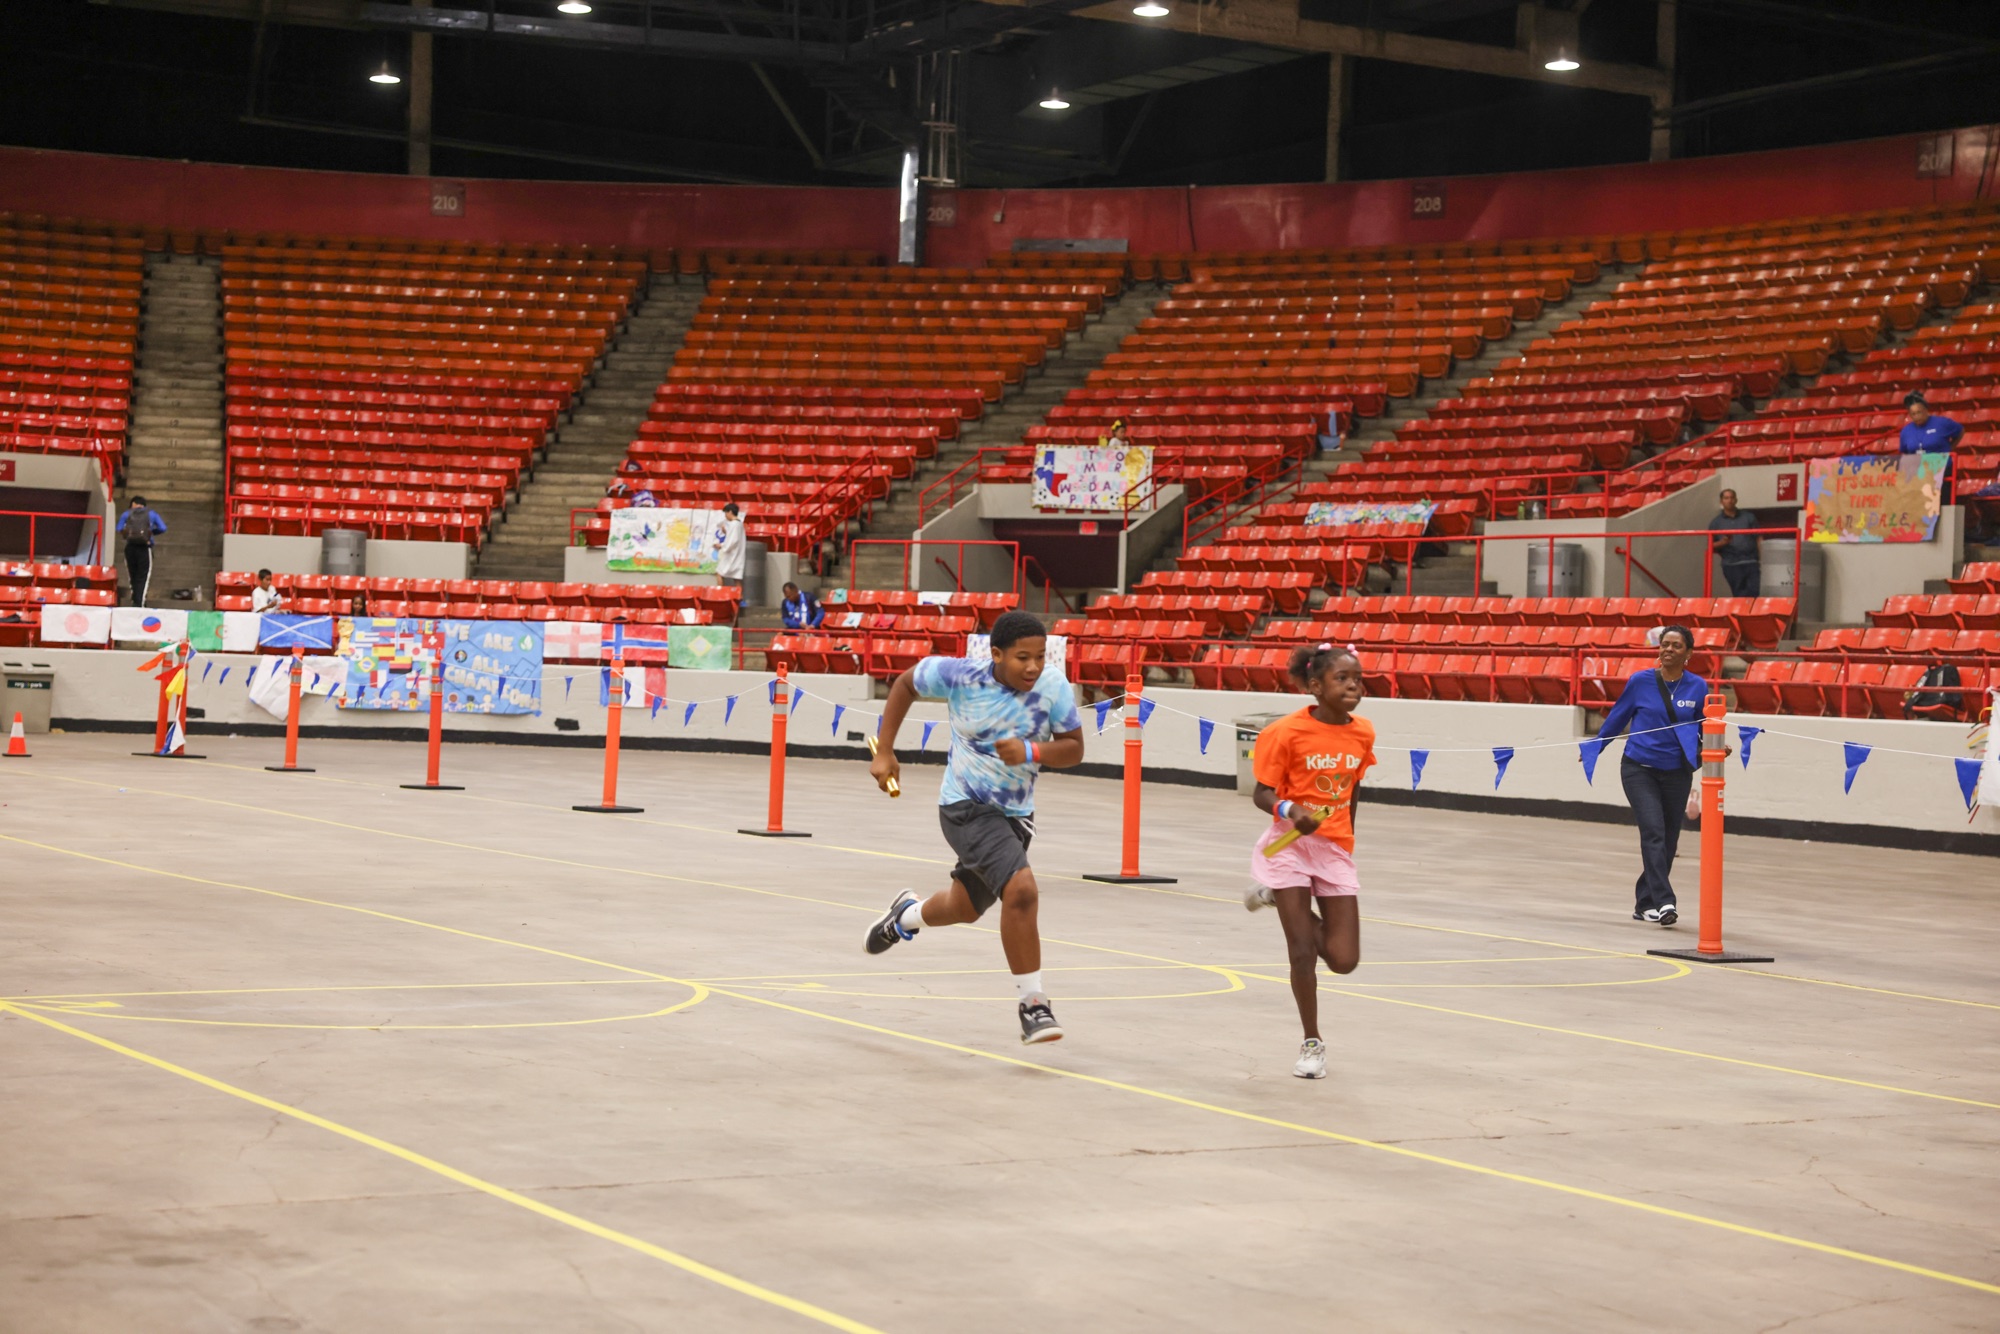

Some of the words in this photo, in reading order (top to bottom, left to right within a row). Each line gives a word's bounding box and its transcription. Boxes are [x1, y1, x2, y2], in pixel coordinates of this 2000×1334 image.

[433, 195, 458, 210] 210
[1414, 196, 1442, 212] 208
[927, 206, 954, 221] 209
[1105, 450, 1125, 462] GO
[1068, 461, 1122, 474] SUMMER
[1060, 480, 1128, 493] WOODLAND
[1860, 471, 1898, 489] SLIME
[1069, 493, 1099, 505] PARK
[400, 619, 441, 634] ALIEF
[443, 622, 471, 642] WE
[482, 632, 515, 652] ARE
[470, 654, 504, 675] ALL
[443, 665, 541, 711] CHAMPIONS
